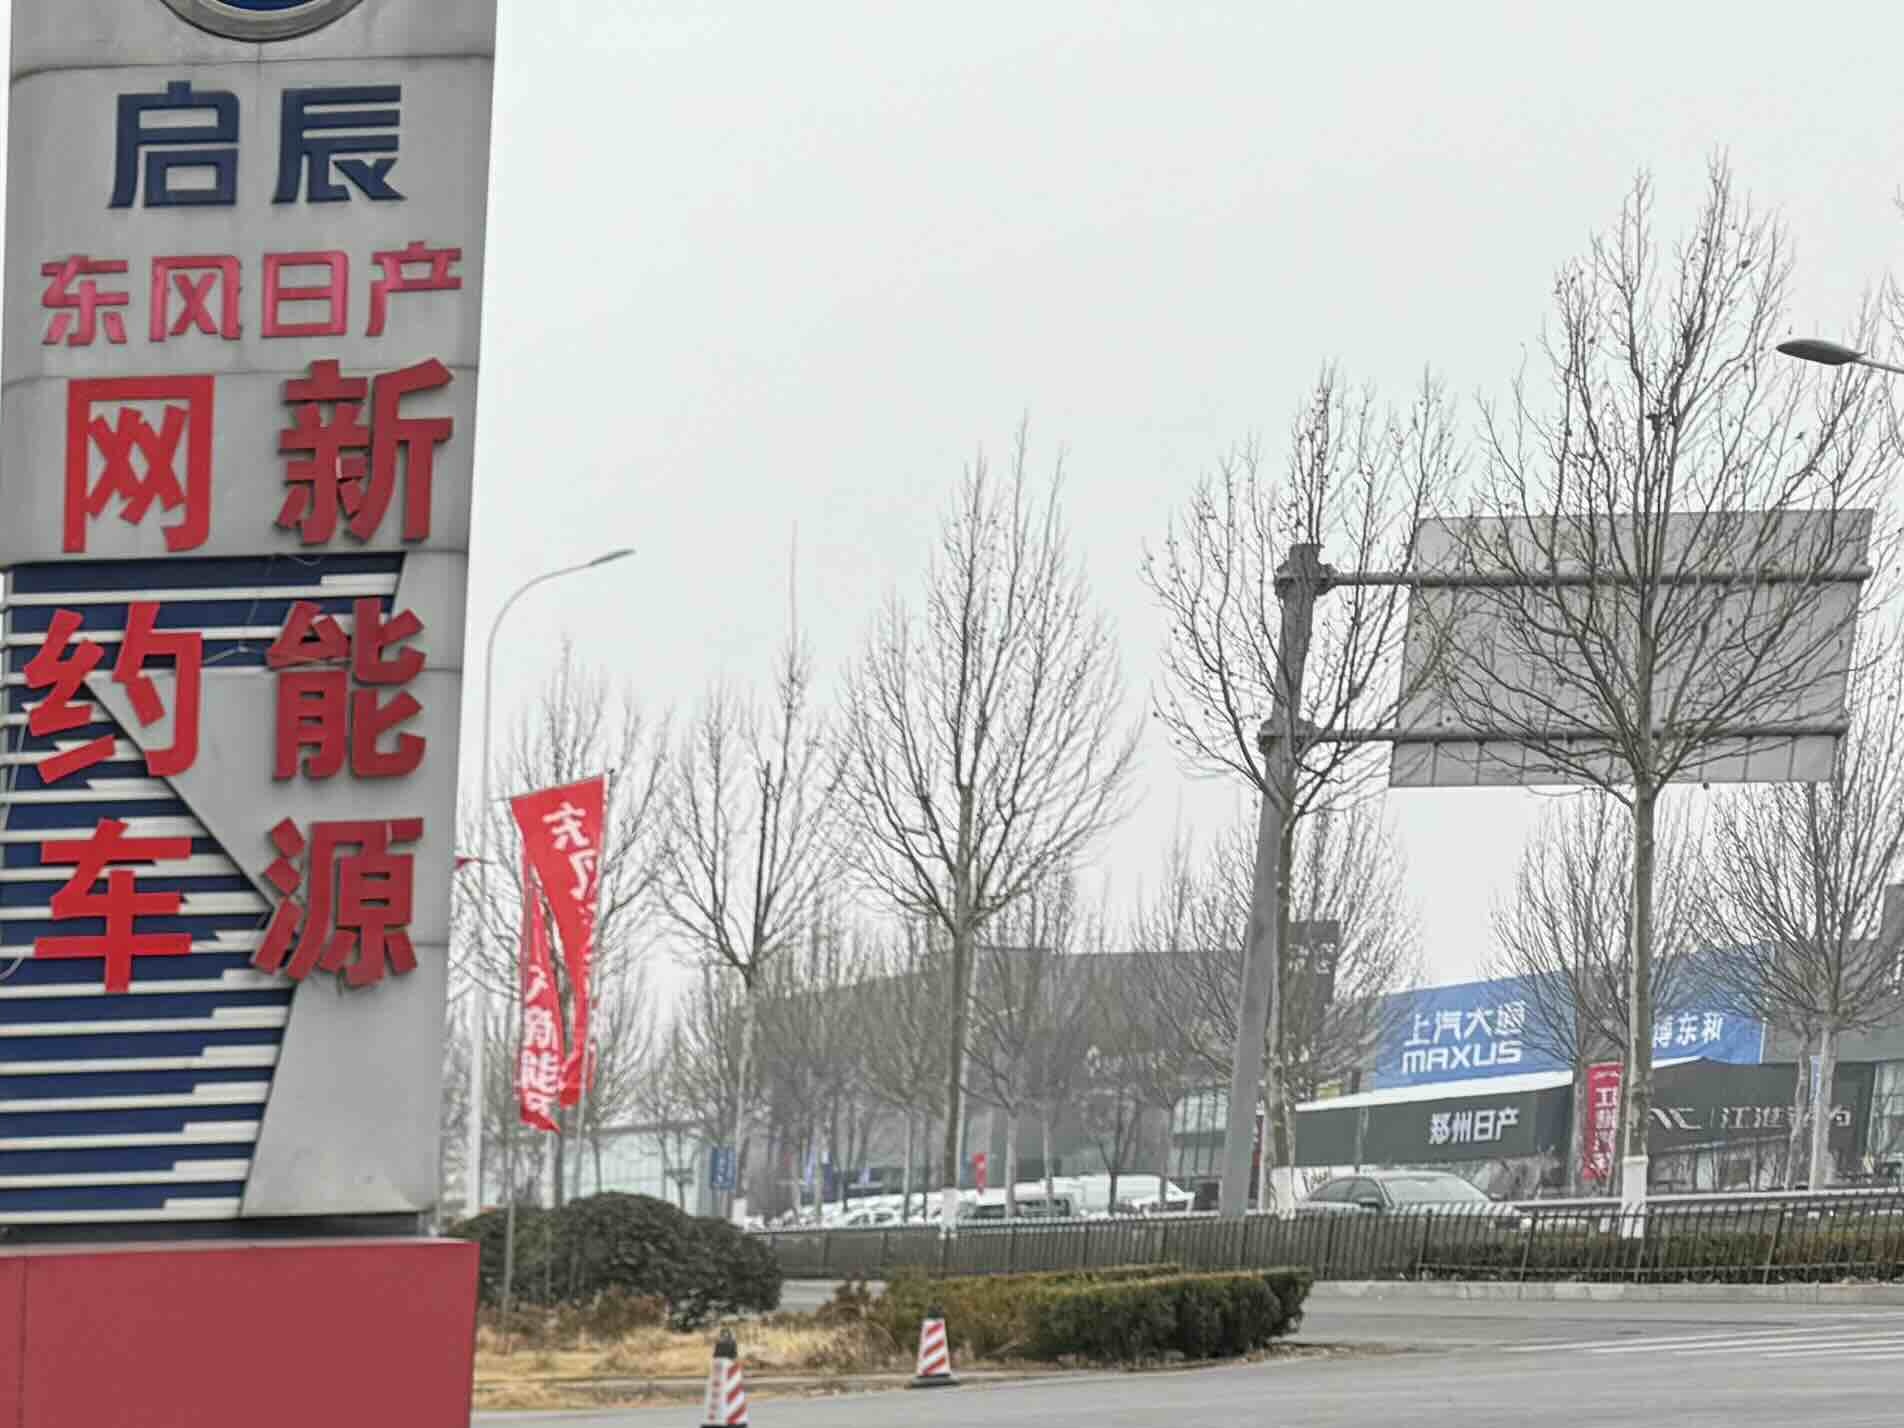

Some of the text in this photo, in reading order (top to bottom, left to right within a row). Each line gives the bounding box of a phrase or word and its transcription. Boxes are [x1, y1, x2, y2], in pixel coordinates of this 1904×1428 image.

[107, 80, 408, 209] 启辰
[40, 240, 462, 347] 东风日产
[1402, 1040, 1523, 1074] MAXUS
[1428, 1107, 1520, 1145] 郑州日产
